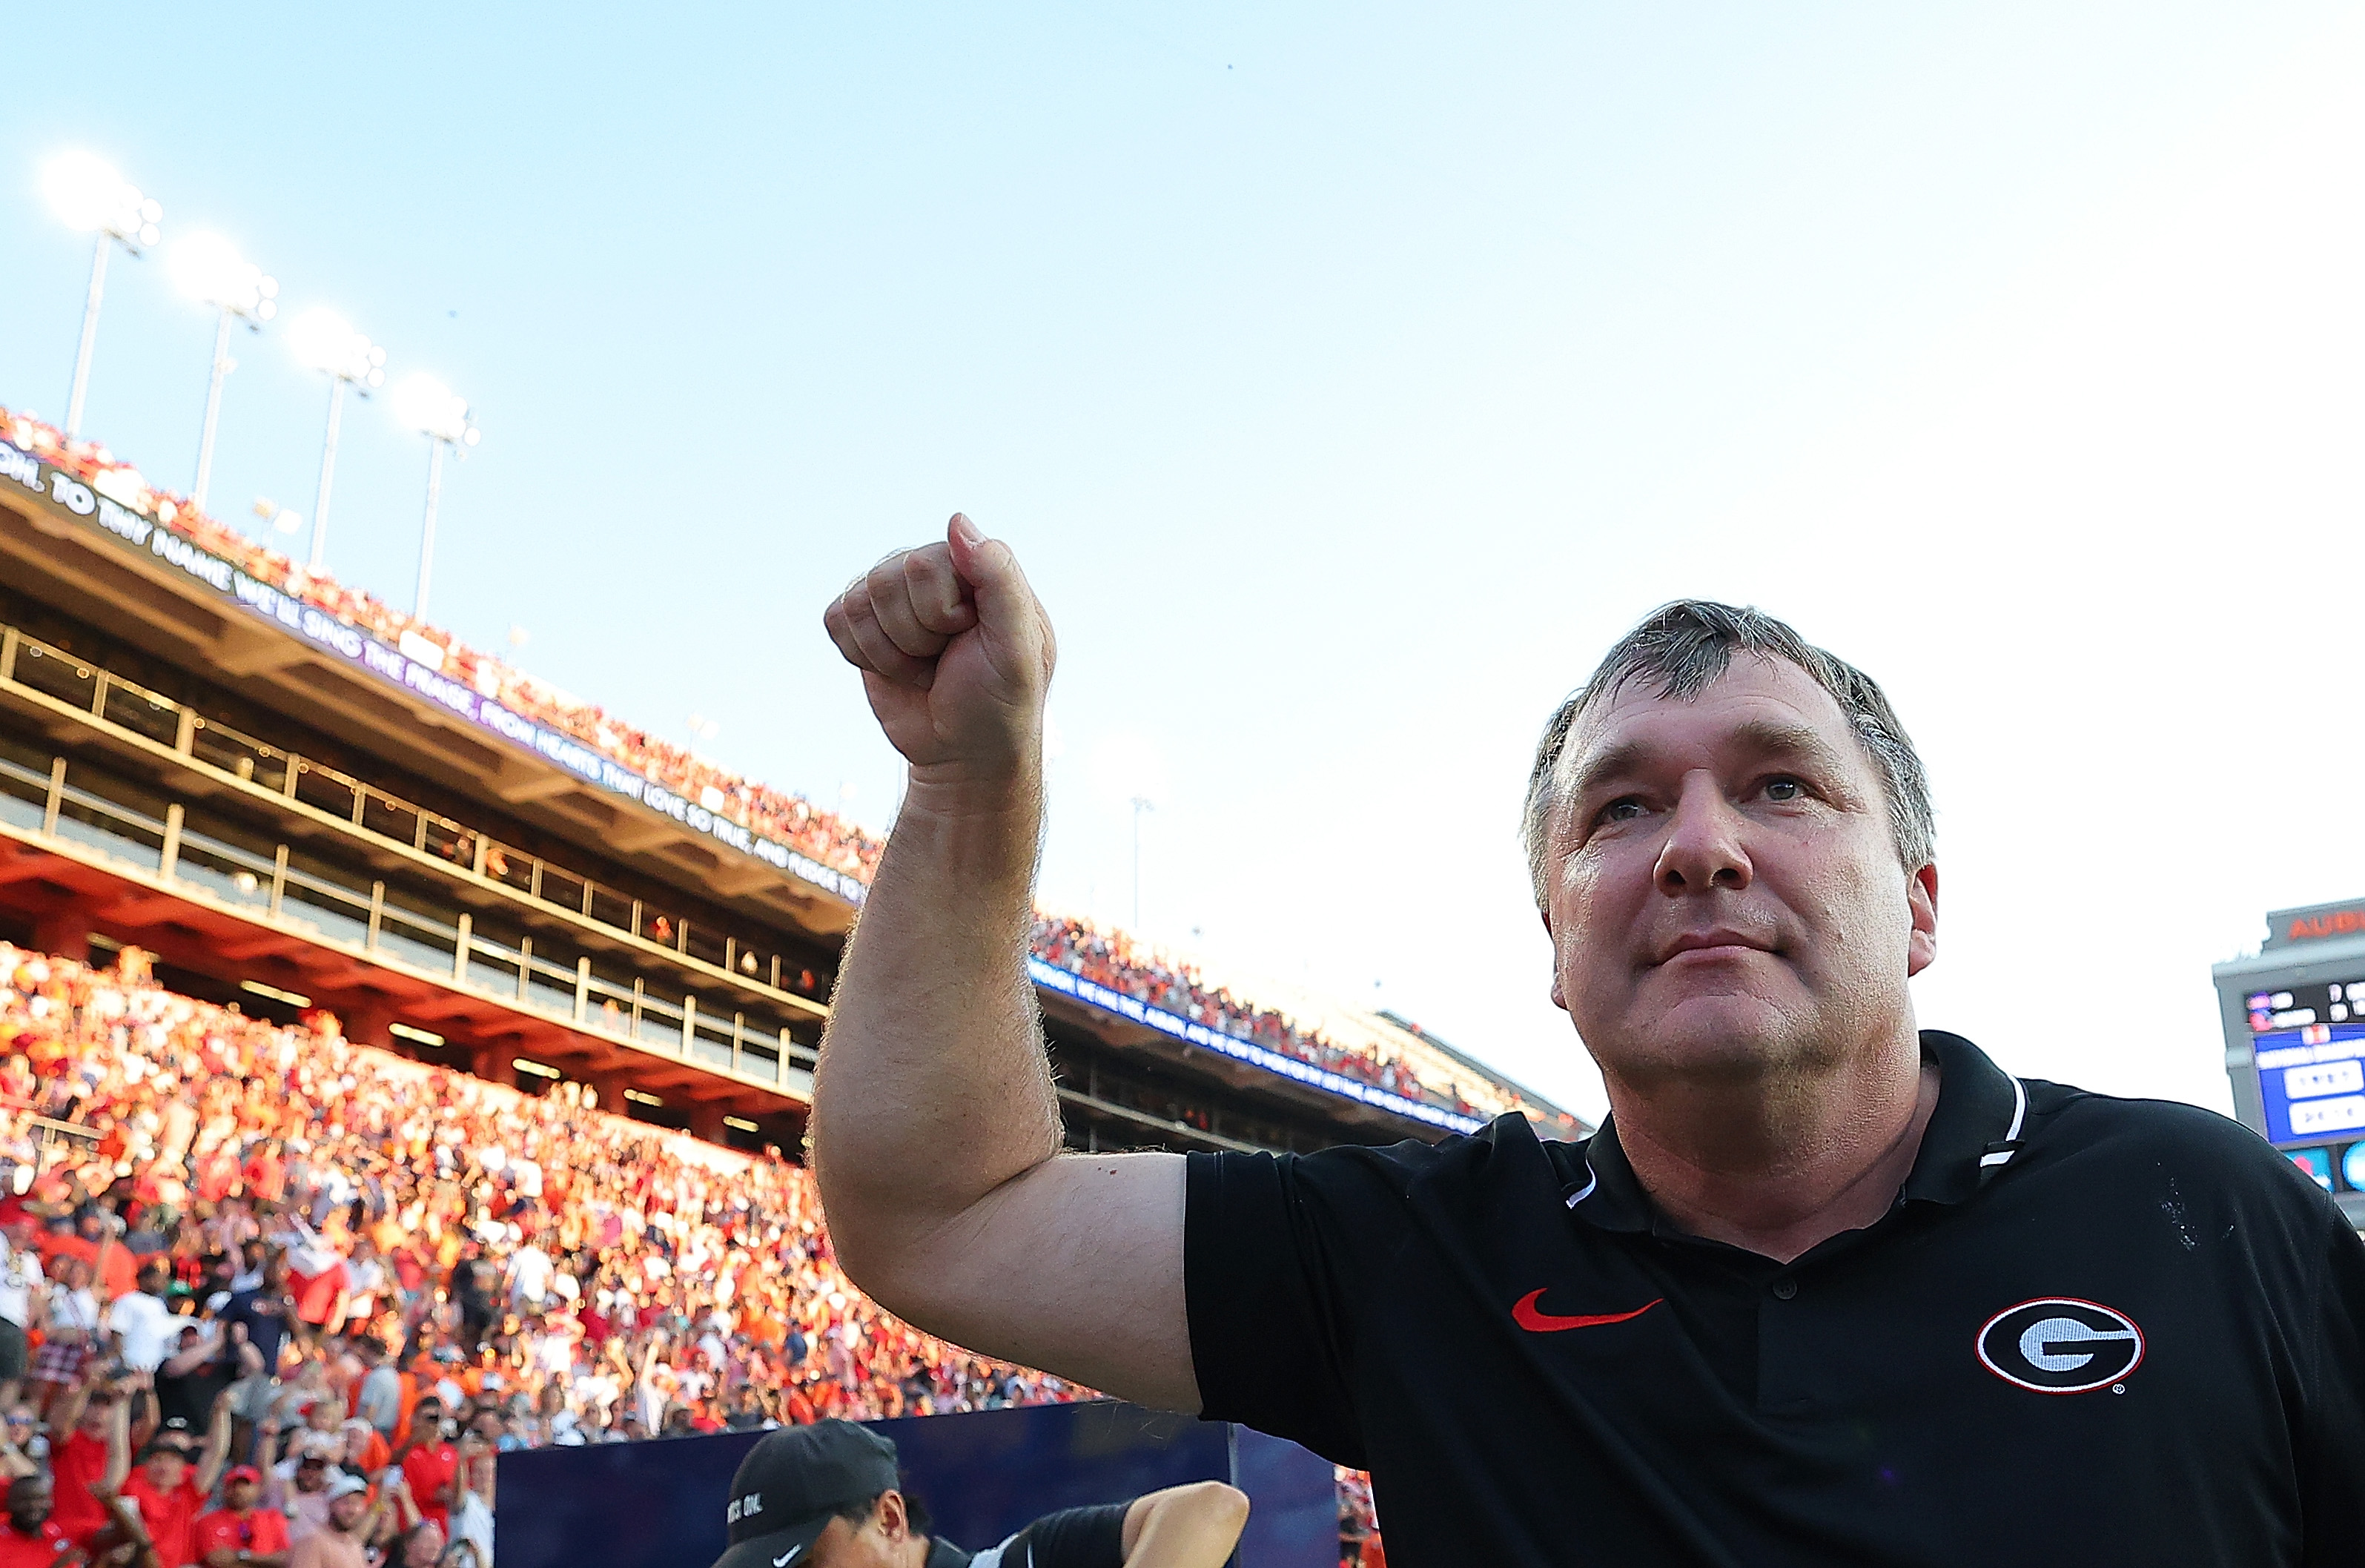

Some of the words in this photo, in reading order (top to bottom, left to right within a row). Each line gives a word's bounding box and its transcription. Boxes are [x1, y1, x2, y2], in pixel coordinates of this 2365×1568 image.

[50, 471, 97, 515] TO
[97, 496, 154, 546] THY
[151, 527, 233, 592] NAME
